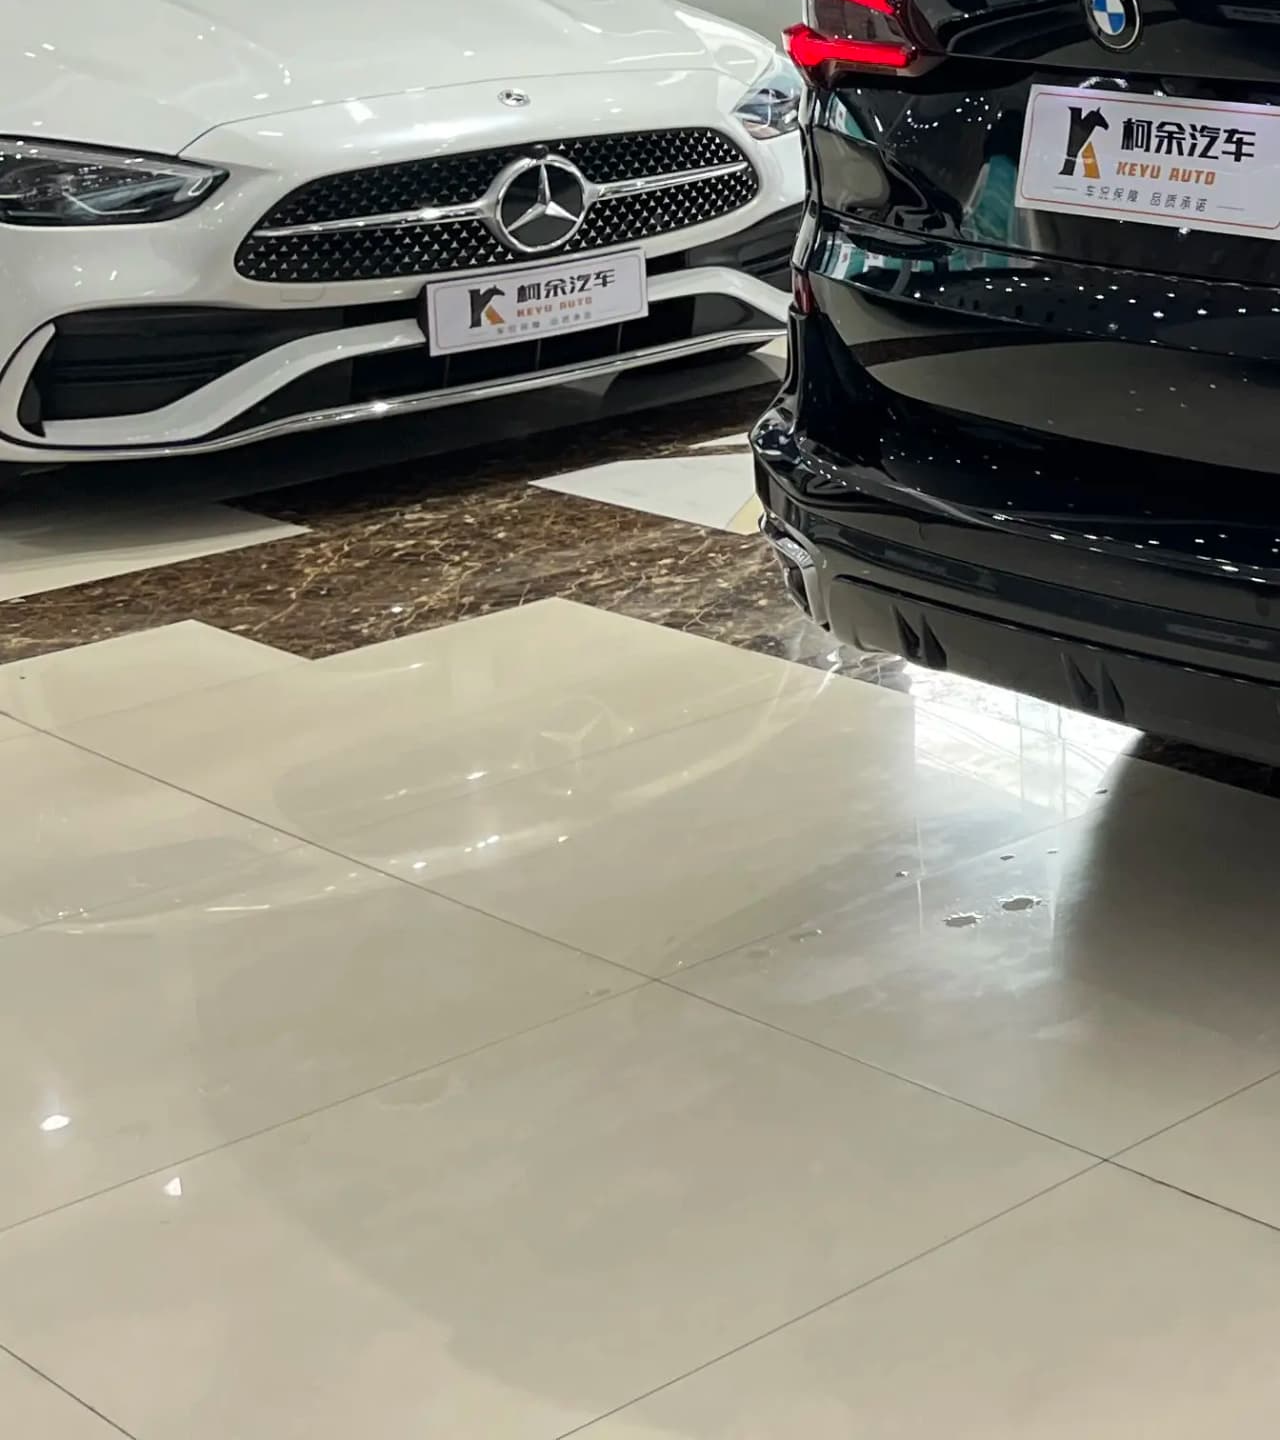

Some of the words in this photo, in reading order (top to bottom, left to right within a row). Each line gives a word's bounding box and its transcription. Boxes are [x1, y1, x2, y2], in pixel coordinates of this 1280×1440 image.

[1121, 118, 1256, 162] 柯余汽车
[1116, 161, 1161, 180] KEYU
[1169, 167, 1216, 185] AUTO
[517, 269, 615, 303] 柯余汽车
[517, 304, 553, 318] KEYU
